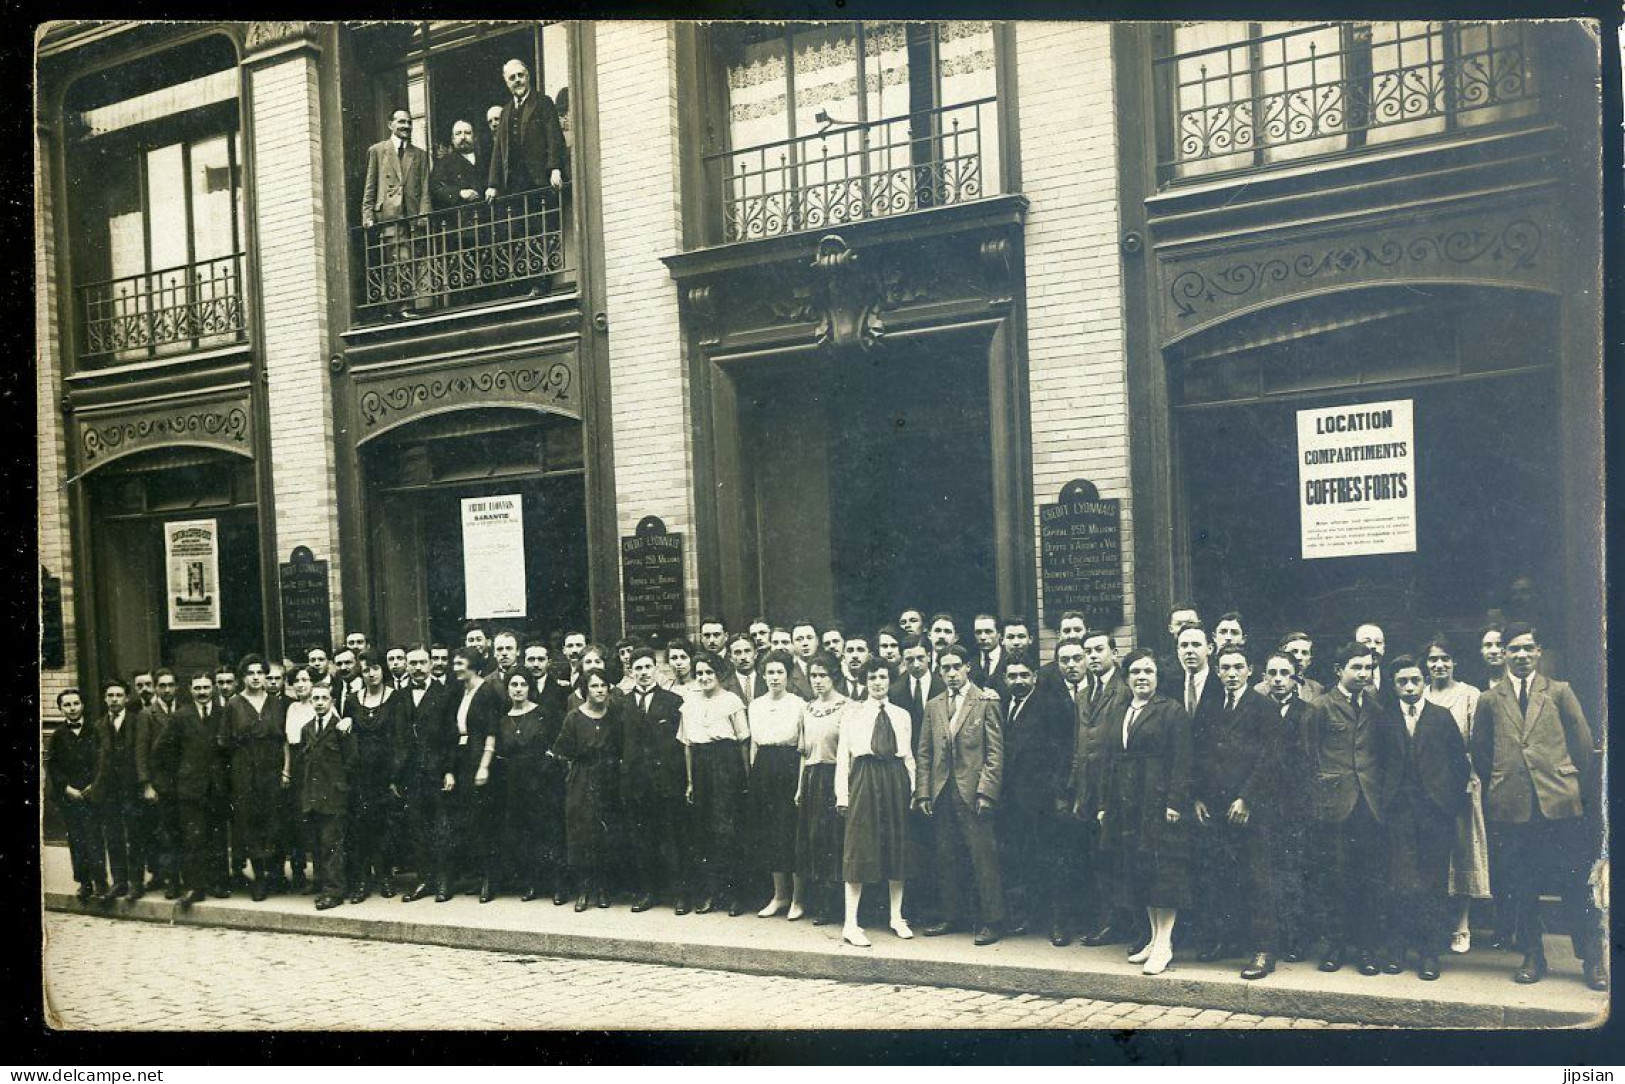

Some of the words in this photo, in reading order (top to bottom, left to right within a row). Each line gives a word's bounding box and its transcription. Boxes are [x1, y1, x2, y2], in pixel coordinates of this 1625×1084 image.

[1316, 409, 1393, 435] LOCATION
[1305, 442, 1407, 465] COMPARTIMENTS
[1074, 501, 1116, 517] LYONNAIS
